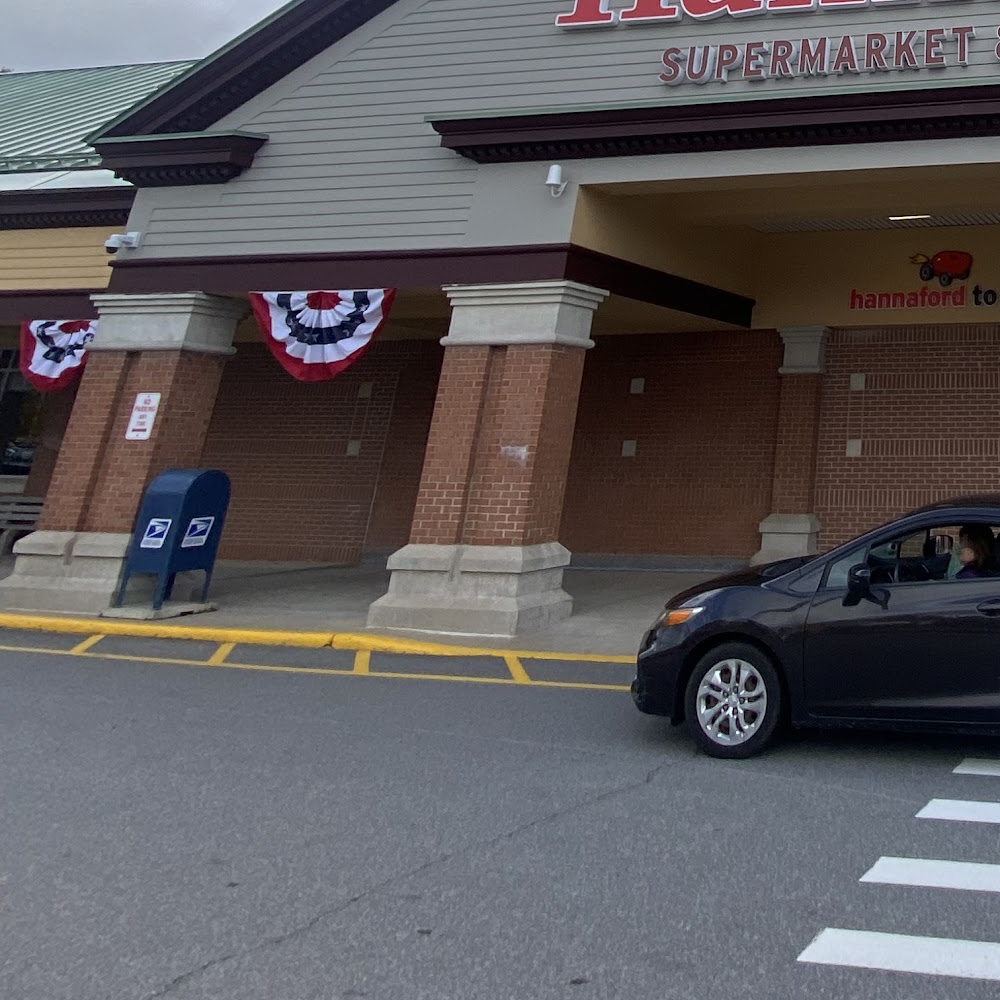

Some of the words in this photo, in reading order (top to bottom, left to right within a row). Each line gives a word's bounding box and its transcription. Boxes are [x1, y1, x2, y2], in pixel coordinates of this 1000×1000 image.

[658, 25, 976, 86] SUPERMARKET
[849, 285, 966, 310] hannaford
[973, 285, 997, 306] to
